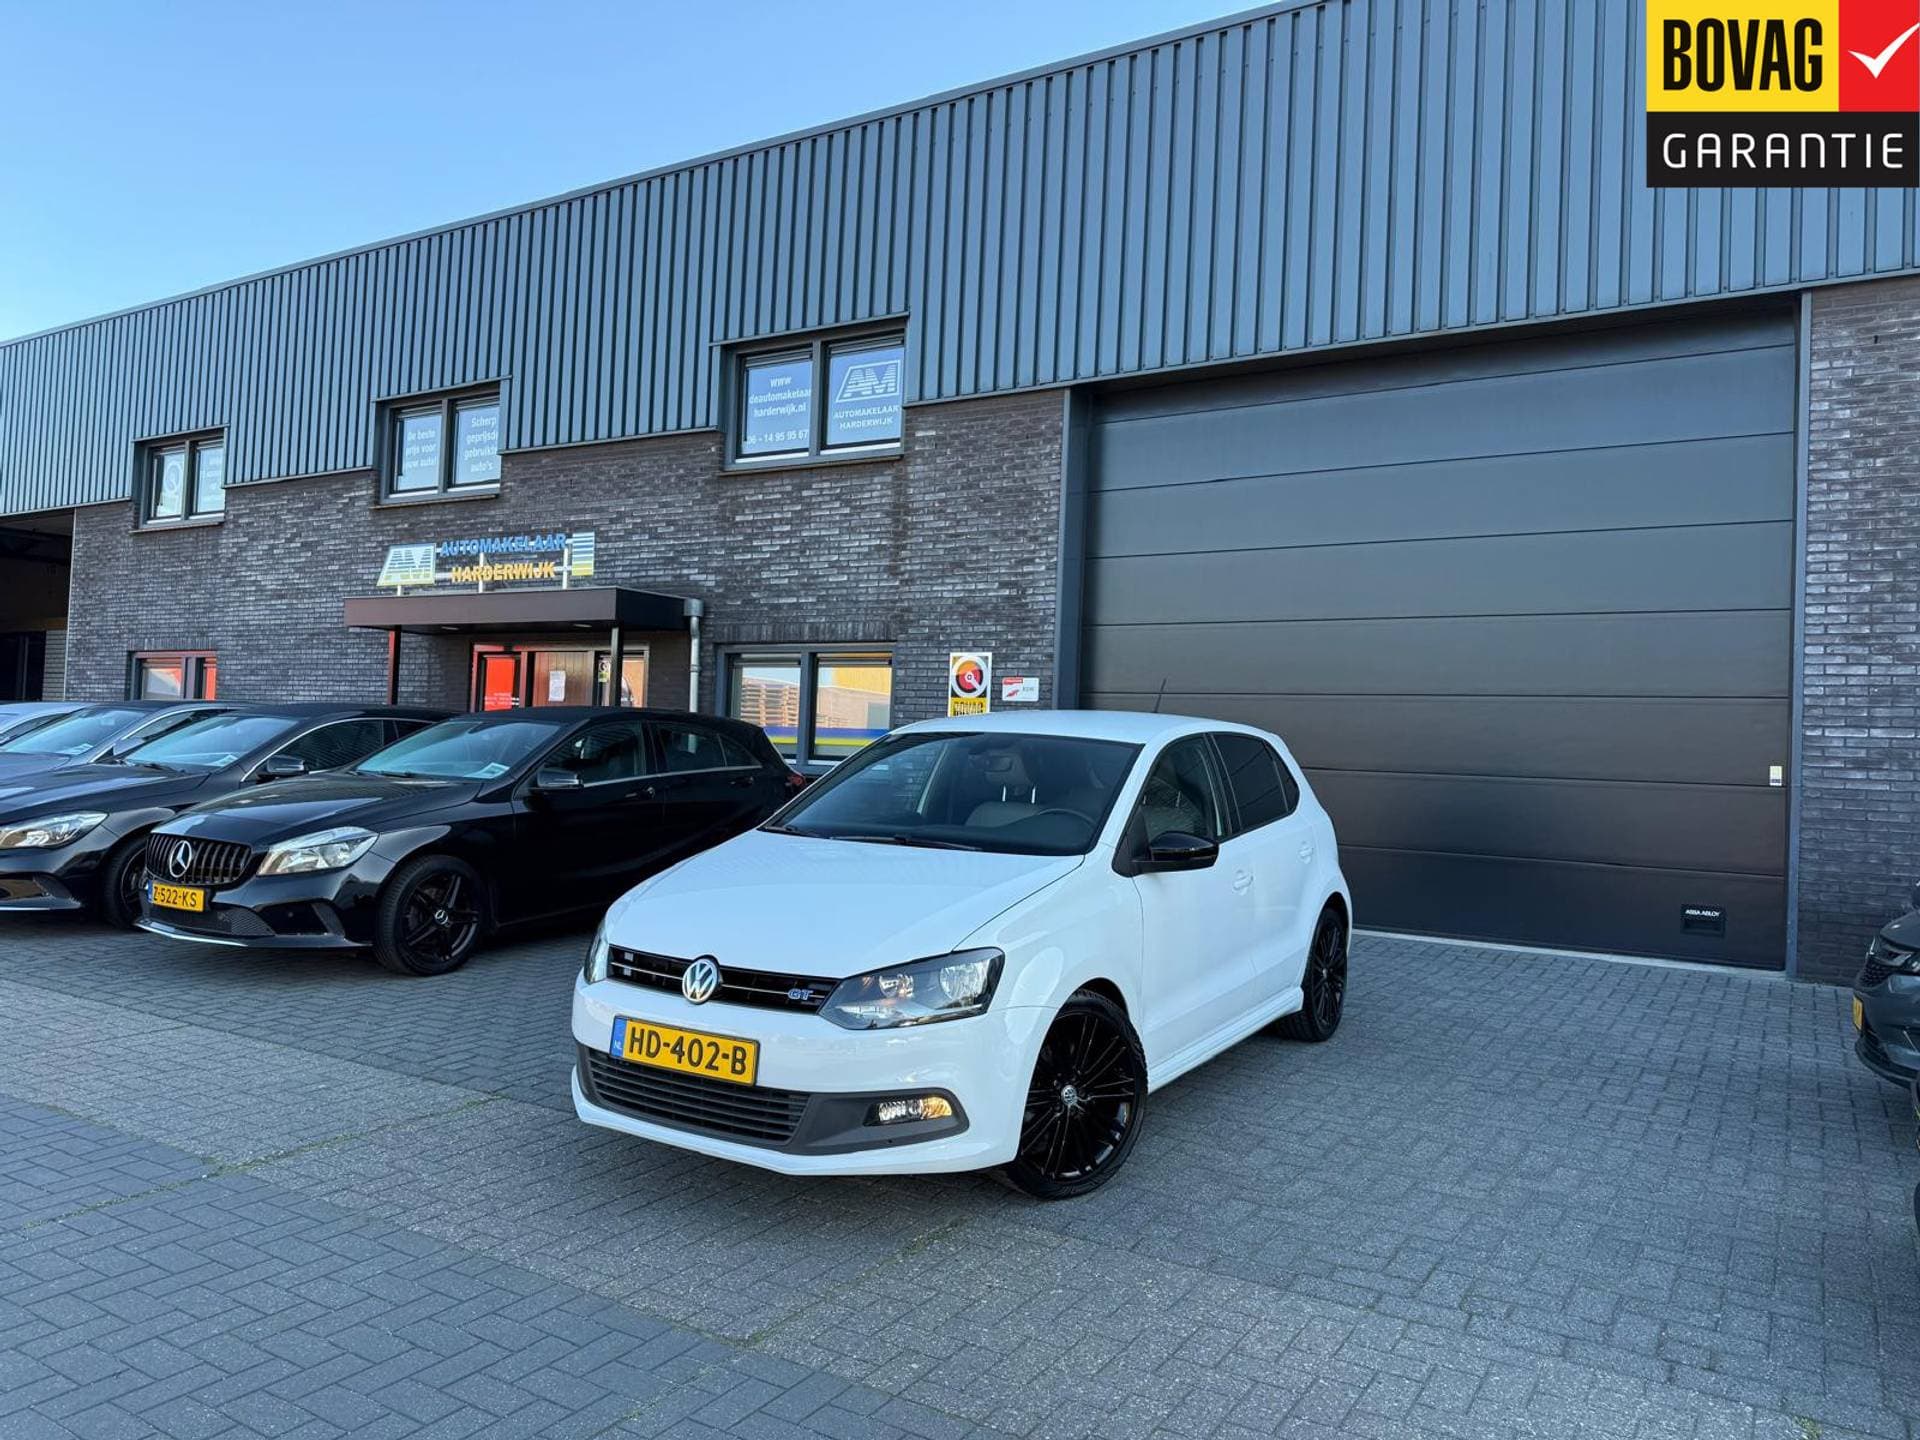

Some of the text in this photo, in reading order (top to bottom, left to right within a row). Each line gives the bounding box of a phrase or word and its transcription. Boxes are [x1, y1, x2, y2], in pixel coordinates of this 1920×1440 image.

[834, 405, 900, 420] AUTOMAKELAAR
[472, 416, 497, 429] Scherp
[839, 418, 893, 431] HARDERWIJK
[440, 533, 567, 557] AUTOMAKELAAR
[451, 561, 556, 583] HARDERWIJK
[154, 886, 198, 908] Z-522-KS
[788, 988, 814, 1001] GT
[629, 1026, 748, 1076] HD-402-B
